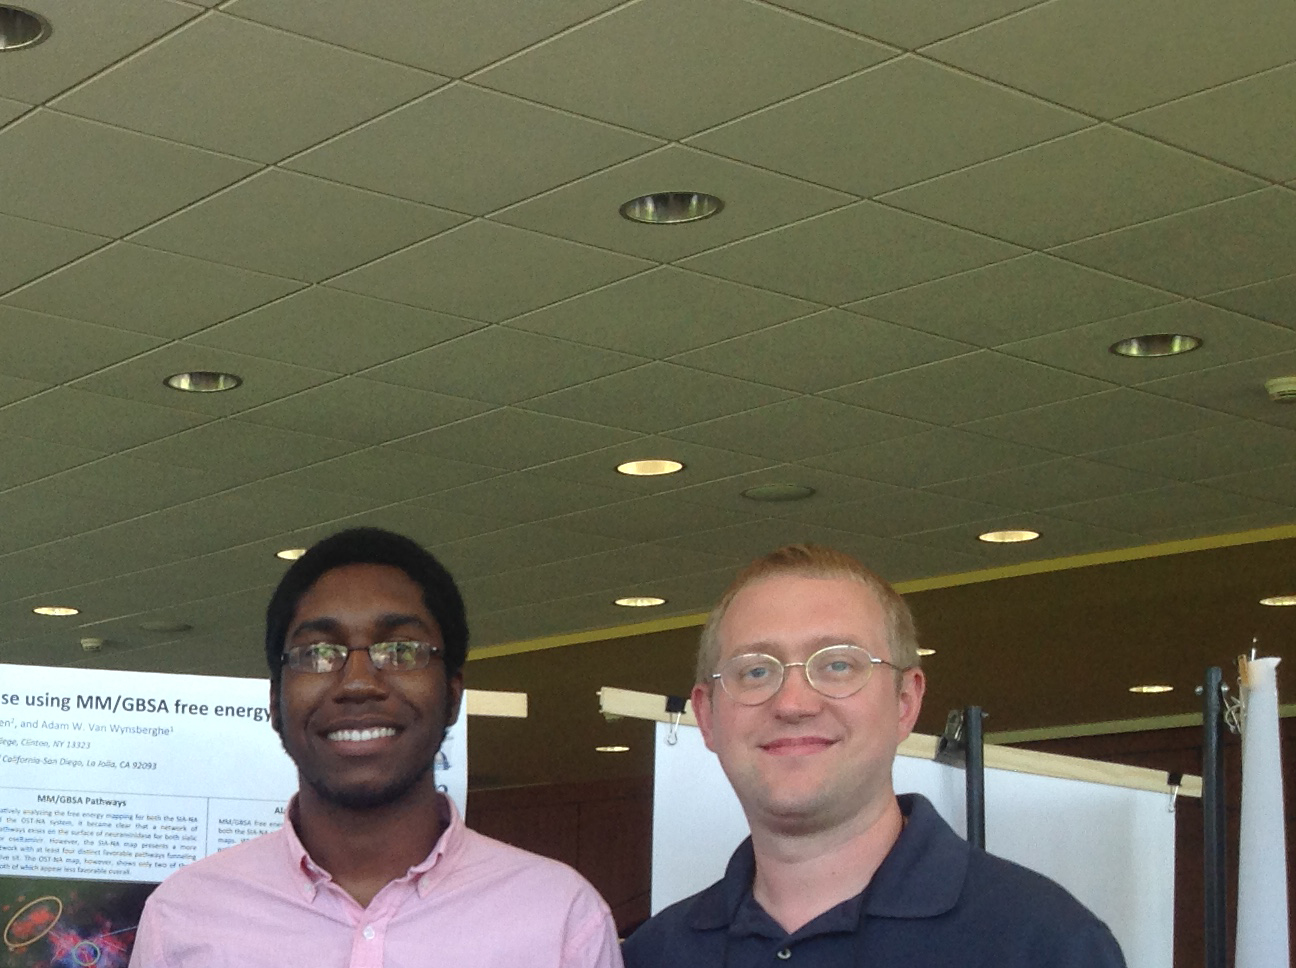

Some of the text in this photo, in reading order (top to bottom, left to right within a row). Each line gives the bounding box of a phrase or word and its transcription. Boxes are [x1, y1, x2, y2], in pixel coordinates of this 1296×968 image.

[25, 693, 70, 711] using
[76, 695, 169, 714] MM/GBSA
[175, 700, 208, 715] free
[214, 705, 271, 722] energy
[21, 719, 38, 728] and
[42, 720, 69, 730] Adam
[73, 722, 84, 731] W.
[89, 724, 106, 732] Van
[21, 739, 50, 748] Clinton,
[53, 740, 64, 748] NY
[67, 741, 91, 749] 13323
[60, 758, 84, 768] Diego,
[87, 759, 95, 767] La
[120, 761, 130, 769] CA
[133, 762, 157, 770] 92093
[38, 795, 126, 808] MM/GBSA Pathways
